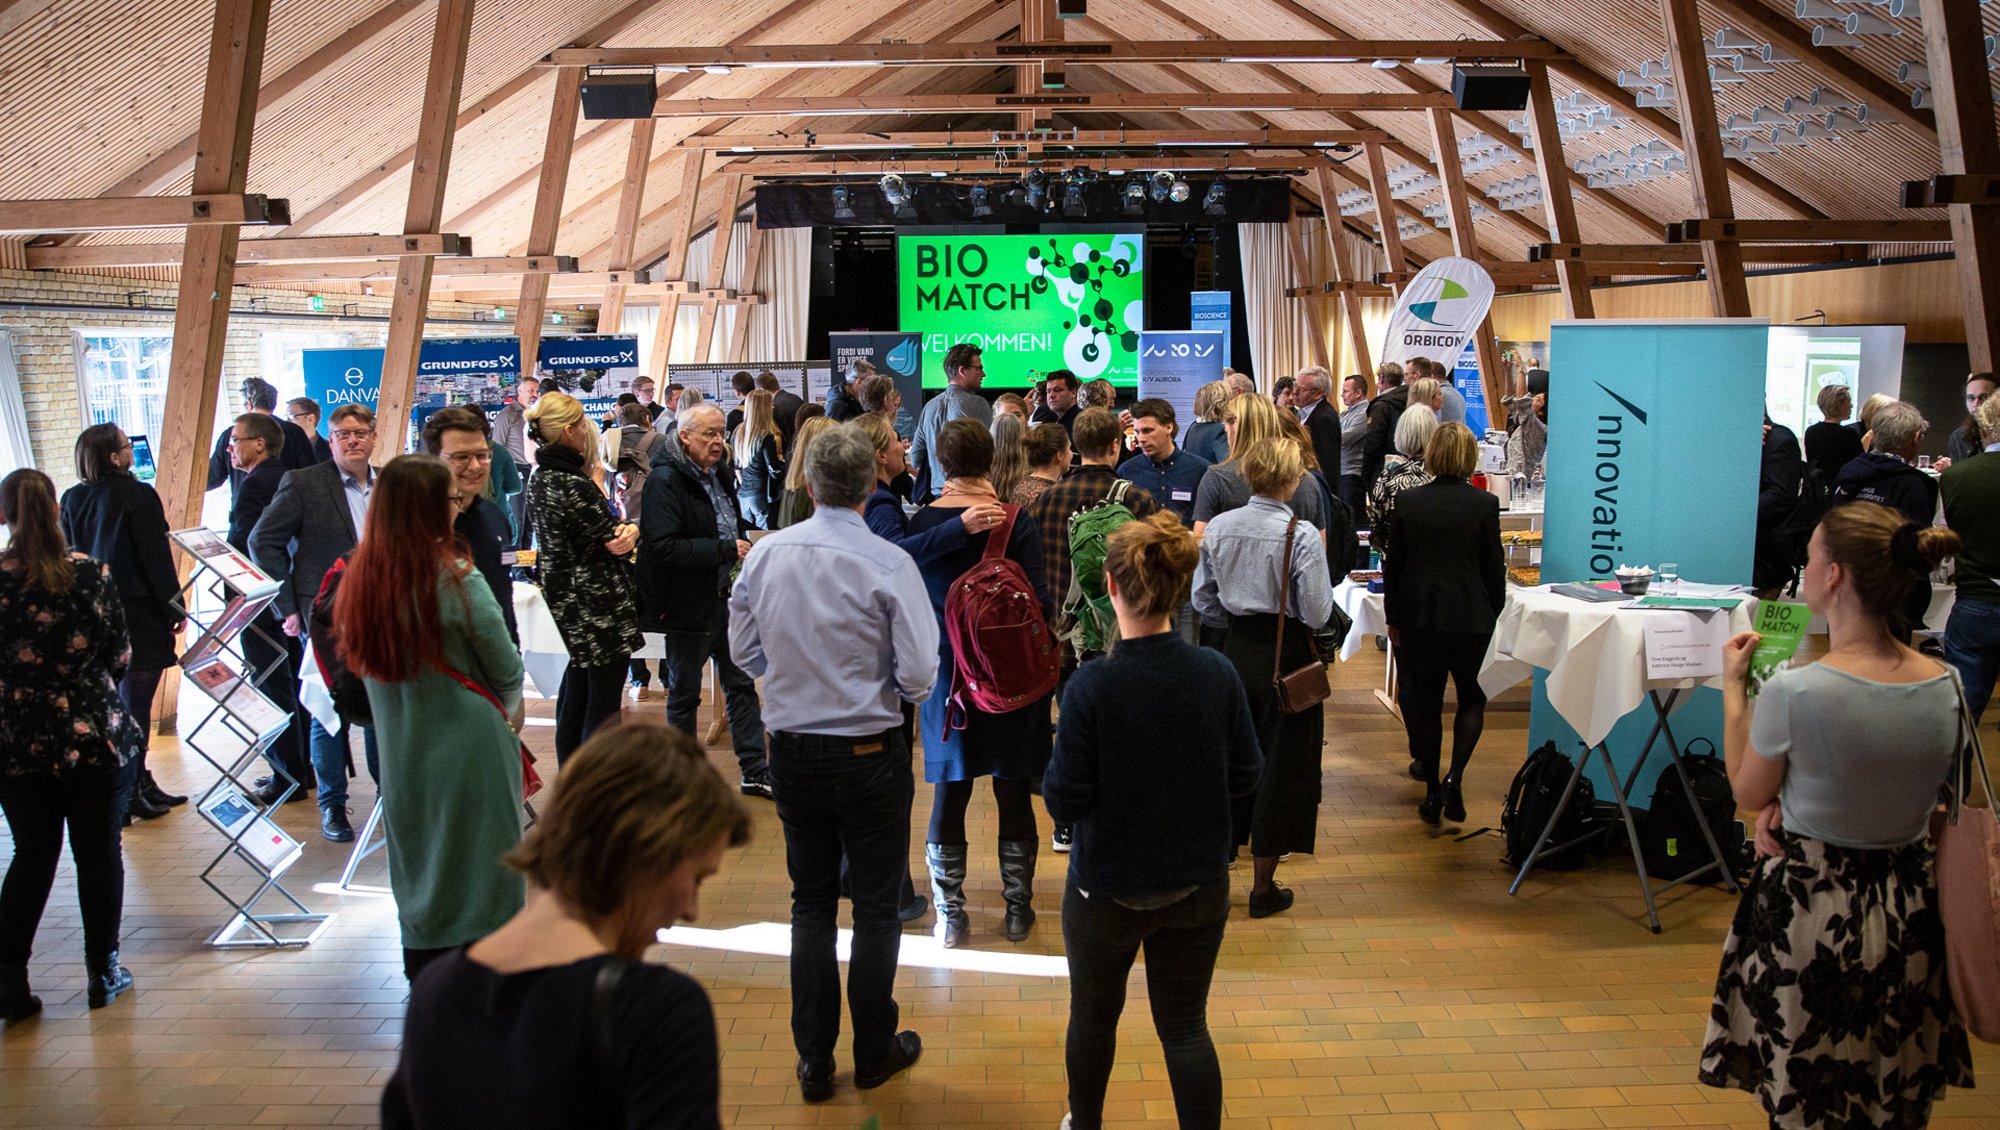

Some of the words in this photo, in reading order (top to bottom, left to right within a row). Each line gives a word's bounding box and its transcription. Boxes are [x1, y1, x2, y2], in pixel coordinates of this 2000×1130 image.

[917, 243, 988, 278] BIO
[917, 282, 1030, 311] MATCH
[1194, 312, 1228, 320] BIOSCIENCE
[1403, 334, 1465, 348] ORBICON
[856, 347, 874, 356] VAND
[421, 359, 499, 370] GRUNDFOS
[548, 355, 620, 365] GRUNDFOS
[1457, 360, 1479, 368] BIOSC
[325, 387, 380, 404] DANVA
[1764, 604, 1792, 620] BIO
[1760, 620, 1801, 633] MATCH
